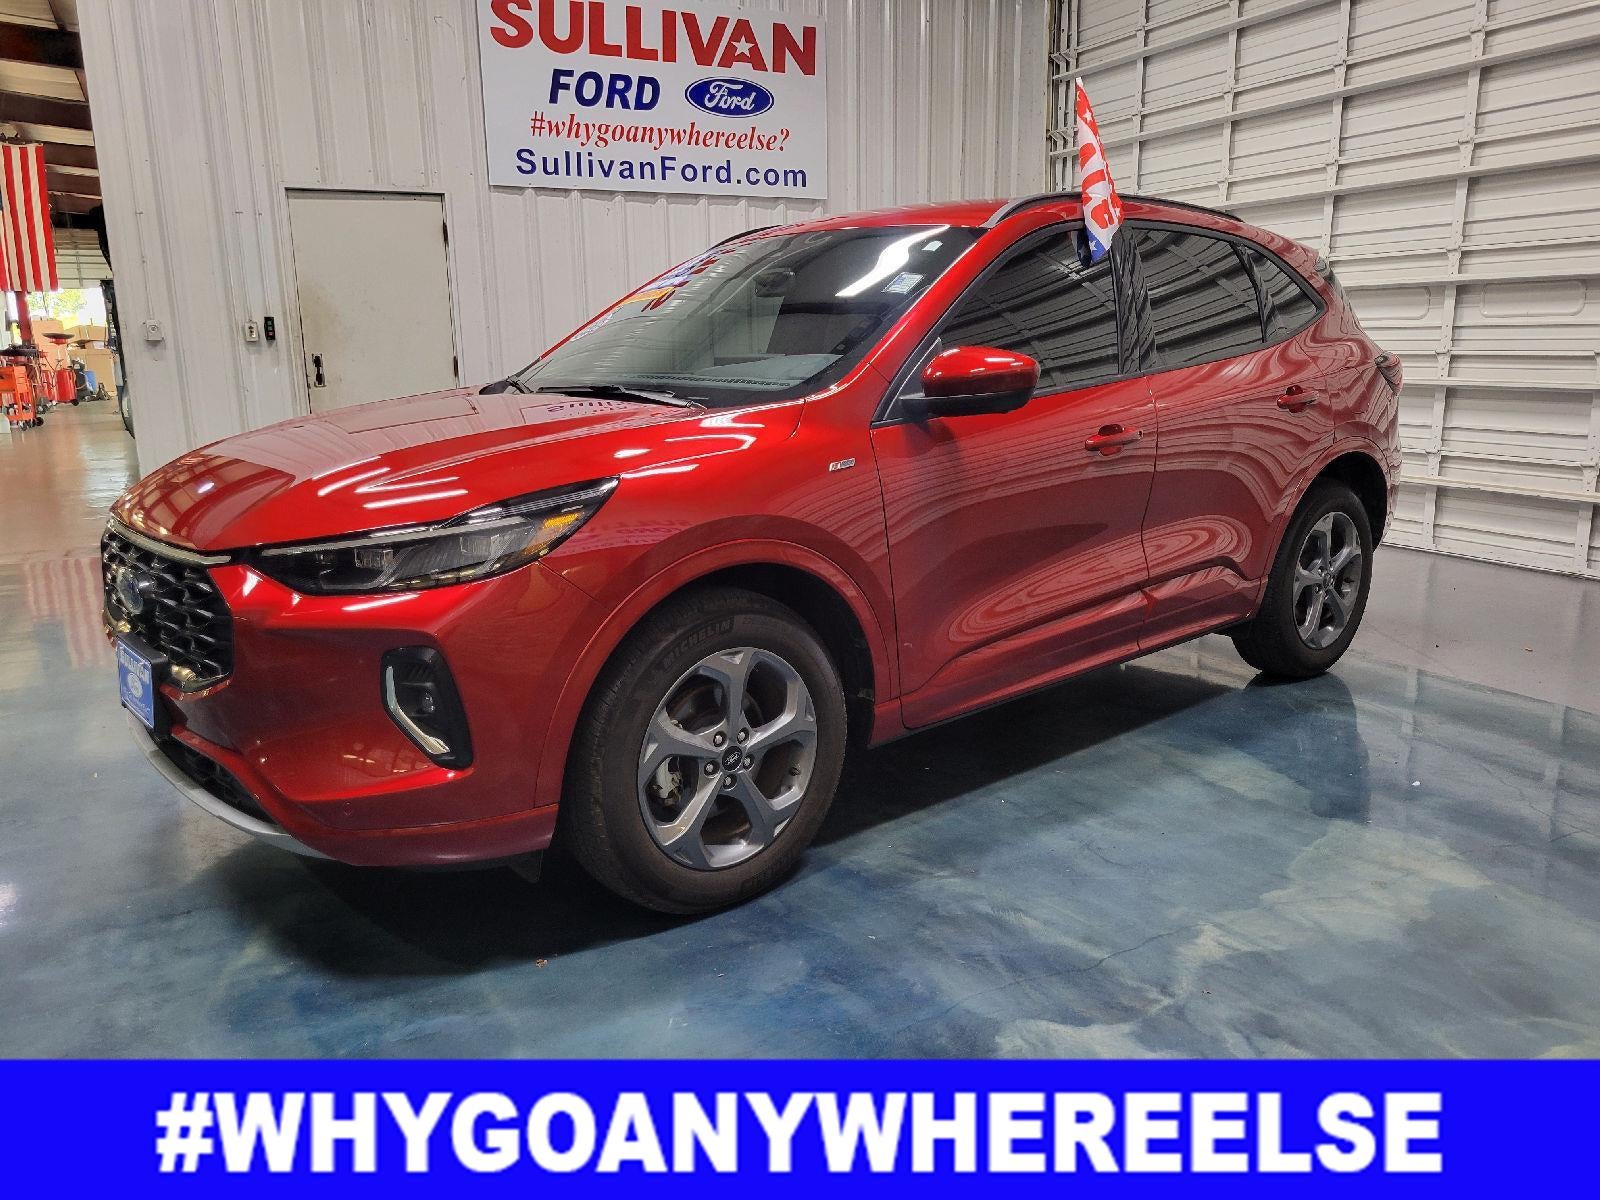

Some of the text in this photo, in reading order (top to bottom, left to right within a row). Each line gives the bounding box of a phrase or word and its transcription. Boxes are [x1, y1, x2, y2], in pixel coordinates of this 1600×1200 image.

[490, 0, 817, 76] SULLIVAN
[548, 69, 661, 111] FORD
[704, 81, 756, 111] Ford
[530, 111, 790, 151] #whygoanywhereelse?
[516, 149, 807, 188] SullivanFord.com
